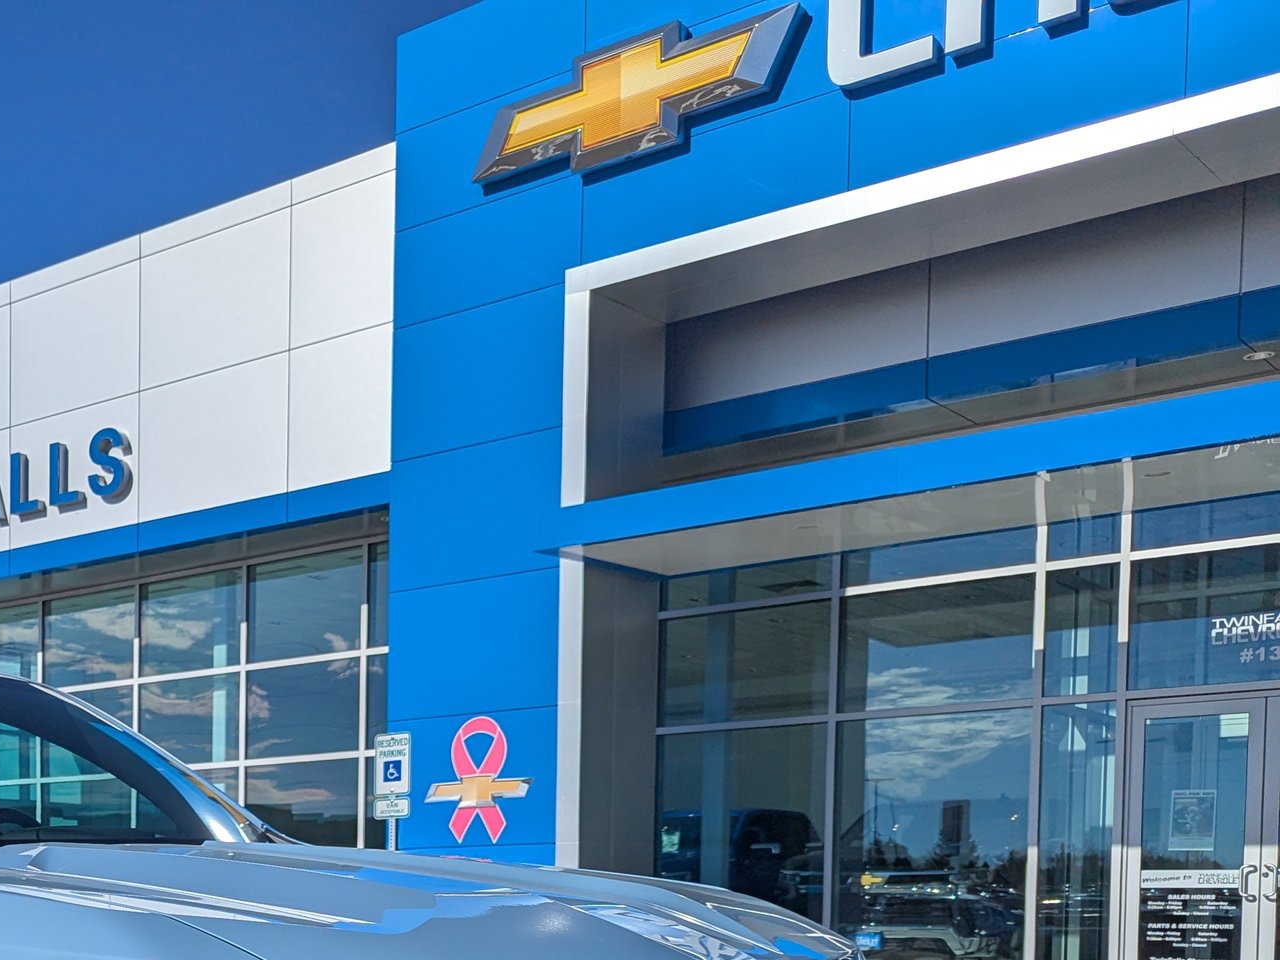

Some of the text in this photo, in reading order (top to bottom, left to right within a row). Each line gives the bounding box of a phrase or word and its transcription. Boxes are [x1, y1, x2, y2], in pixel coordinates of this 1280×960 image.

[1211, 622, 1280, 645] CHEVR
[377, 738, 408, 748] RESERVED
[379, 749, 406, 758] PARKING
